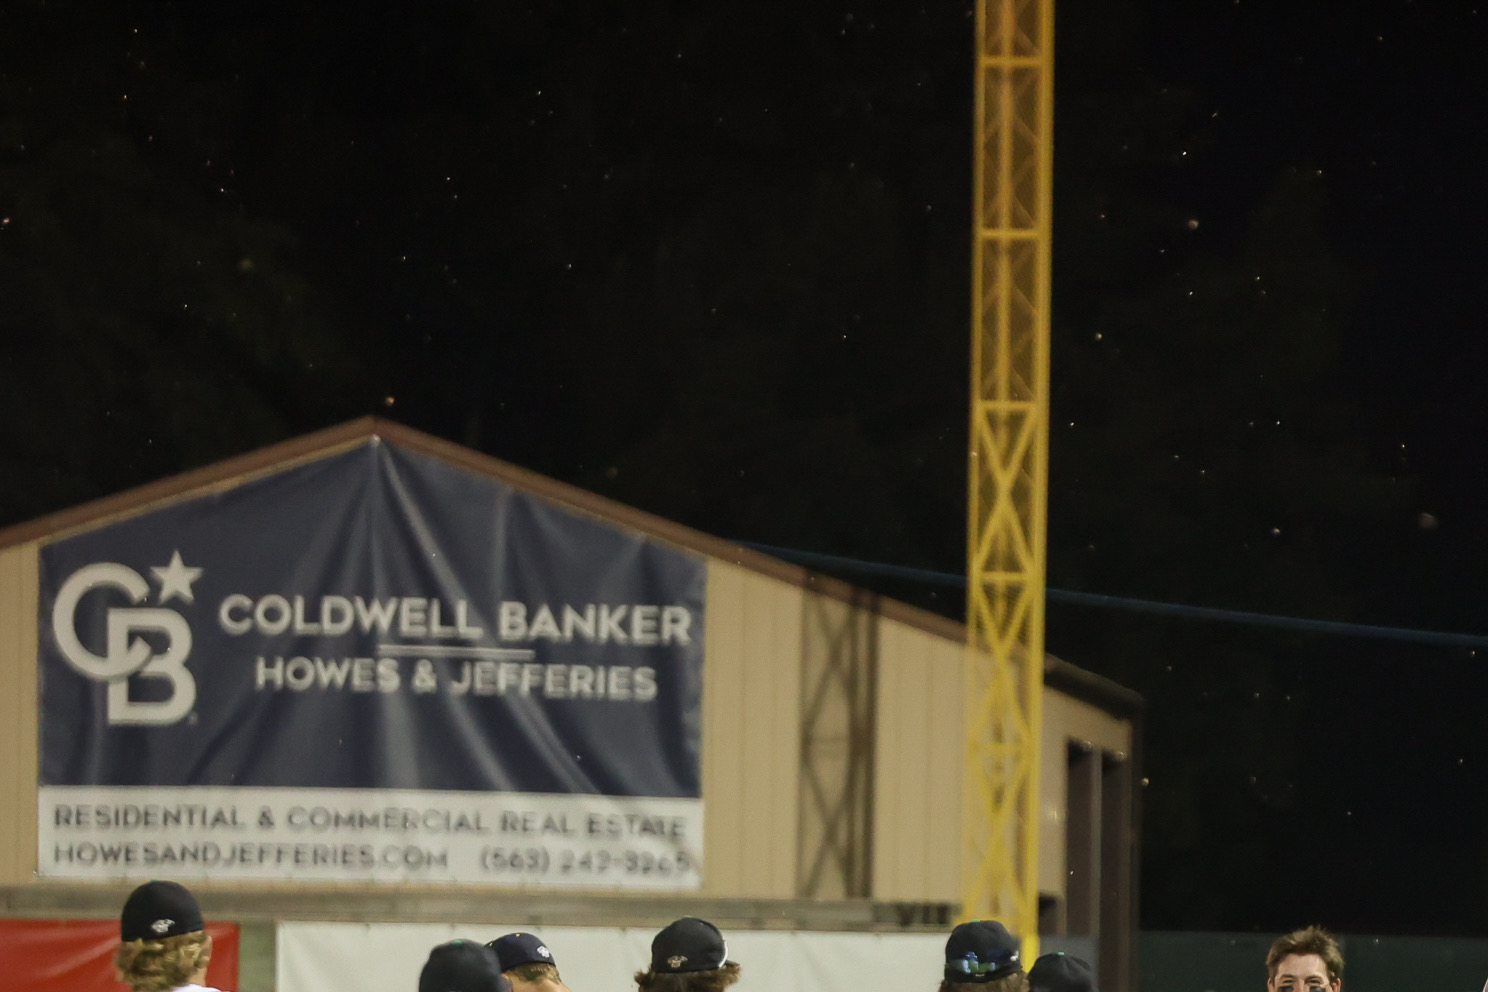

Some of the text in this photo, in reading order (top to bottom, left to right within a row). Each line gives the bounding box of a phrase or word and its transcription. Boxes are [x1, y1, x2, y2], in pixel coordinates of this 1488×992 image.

[219, 594, 692, 646] COLDWELL BANKER
[52, 561, 196, 726] CB
[255, 656, 658, 700] HOWES & JEFFERIES
[54, 804, 688, 839] RESIDENTIAL & COMMERCIAL REAL ESTATE
[54, 841, 449, 870] HOWESANDJEFFERIES.COM
